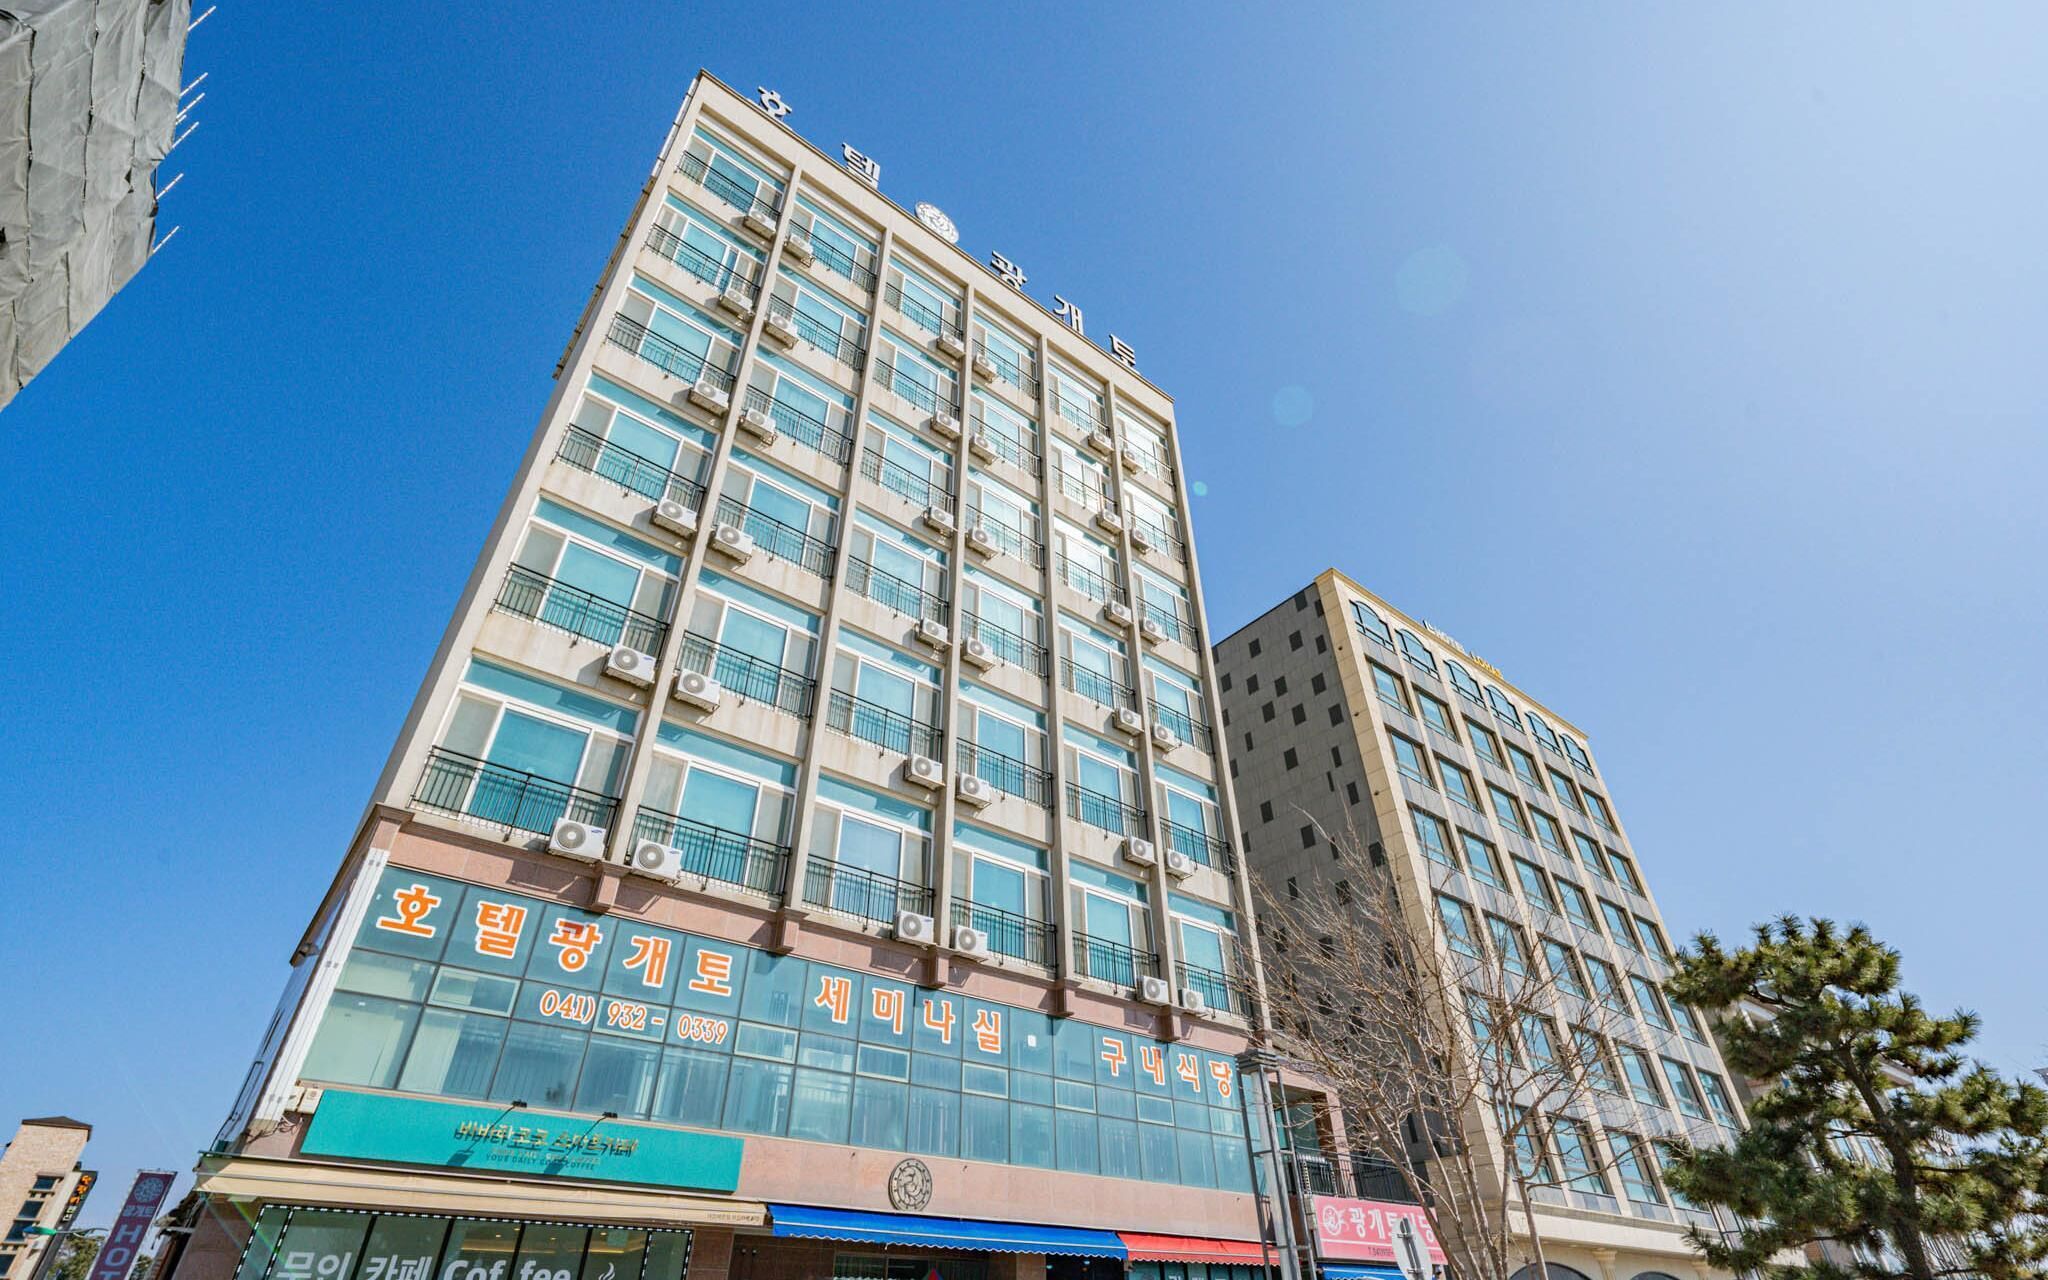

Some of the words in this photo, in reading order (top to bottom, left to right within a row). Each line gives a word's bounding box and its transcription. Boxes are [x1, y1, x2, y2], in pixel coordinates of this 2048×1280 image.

[539, 989, 596, 1025] 041)
[815, 975, 1002, 1055] 세미나실
[1101, 1036, 1233, 1098] 구내식당
[1349, 1207, 1436, 1243] 광개당
[366, 1255, 432, 1280] 카페
